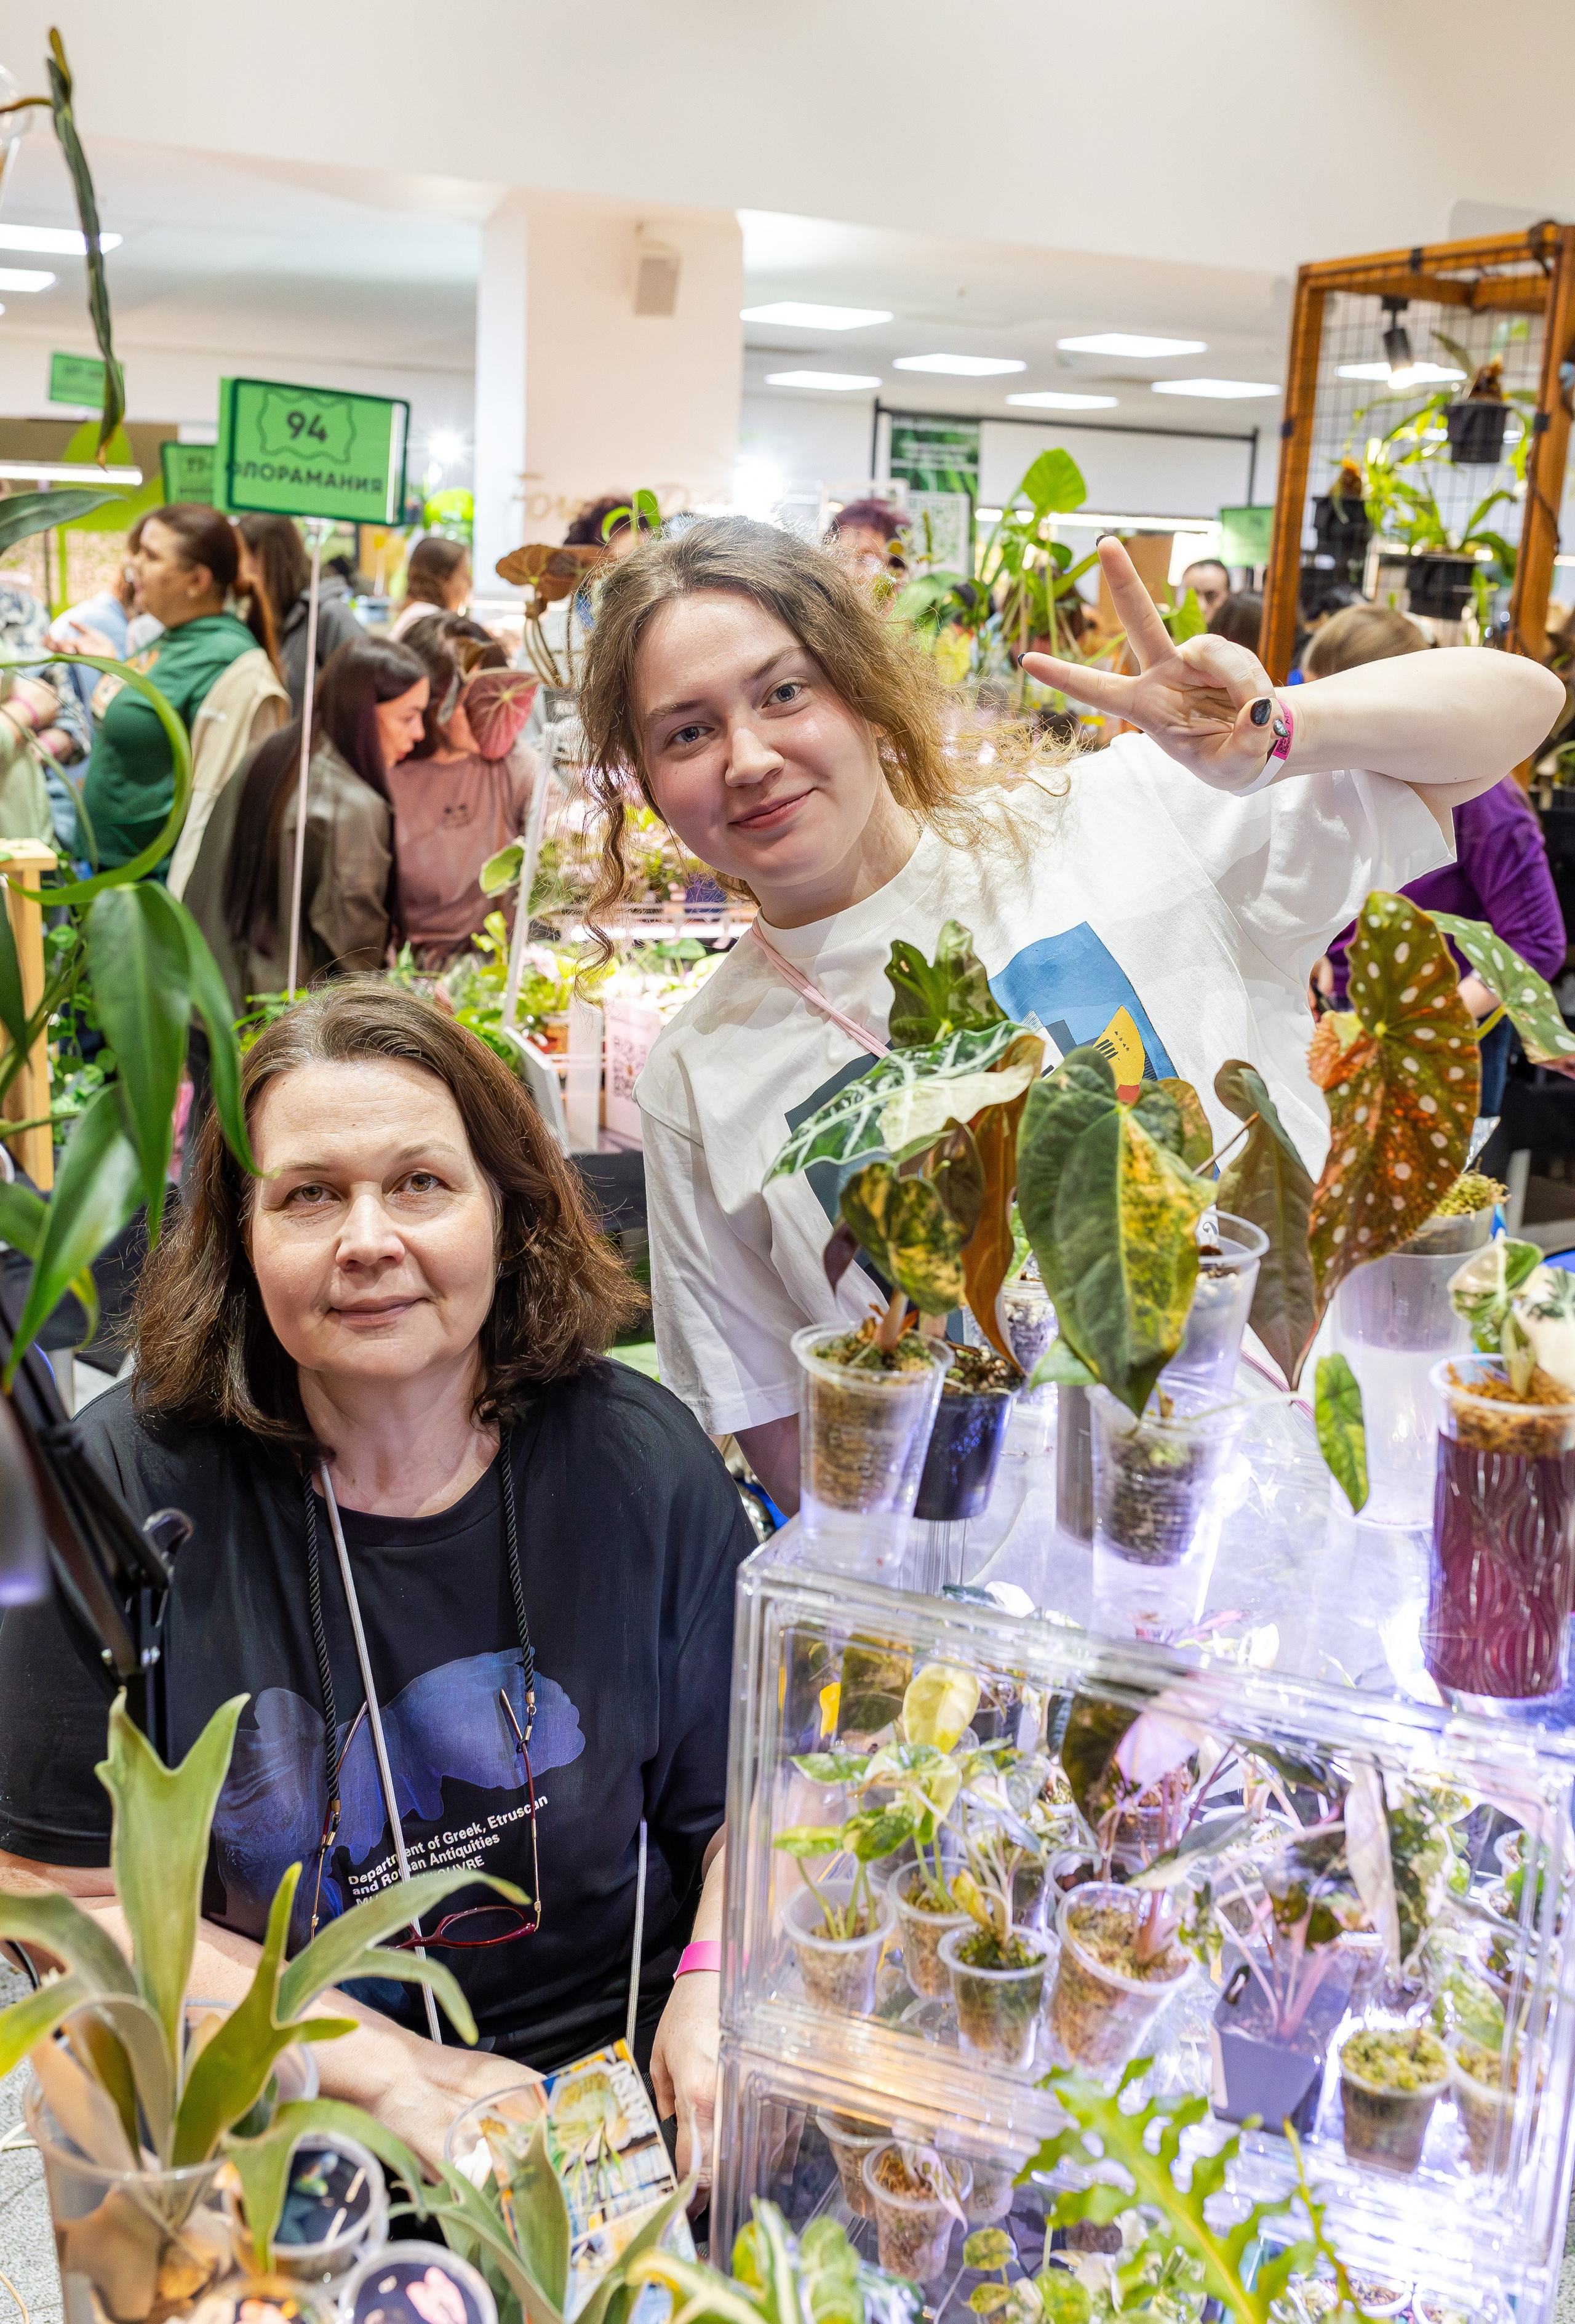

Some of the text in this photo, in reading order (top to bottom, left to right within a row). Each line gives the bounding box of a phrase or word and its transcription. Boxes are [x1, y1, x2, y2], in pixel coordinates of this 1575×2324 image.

[285, 410, 327, 443] 94
[428, 1835, 441, 1850] of
[442, 1822, 487, 1845] Greek,
[352, 1880, 380, 1895] and
[430, 1833, 500, 1867] Antiquities
